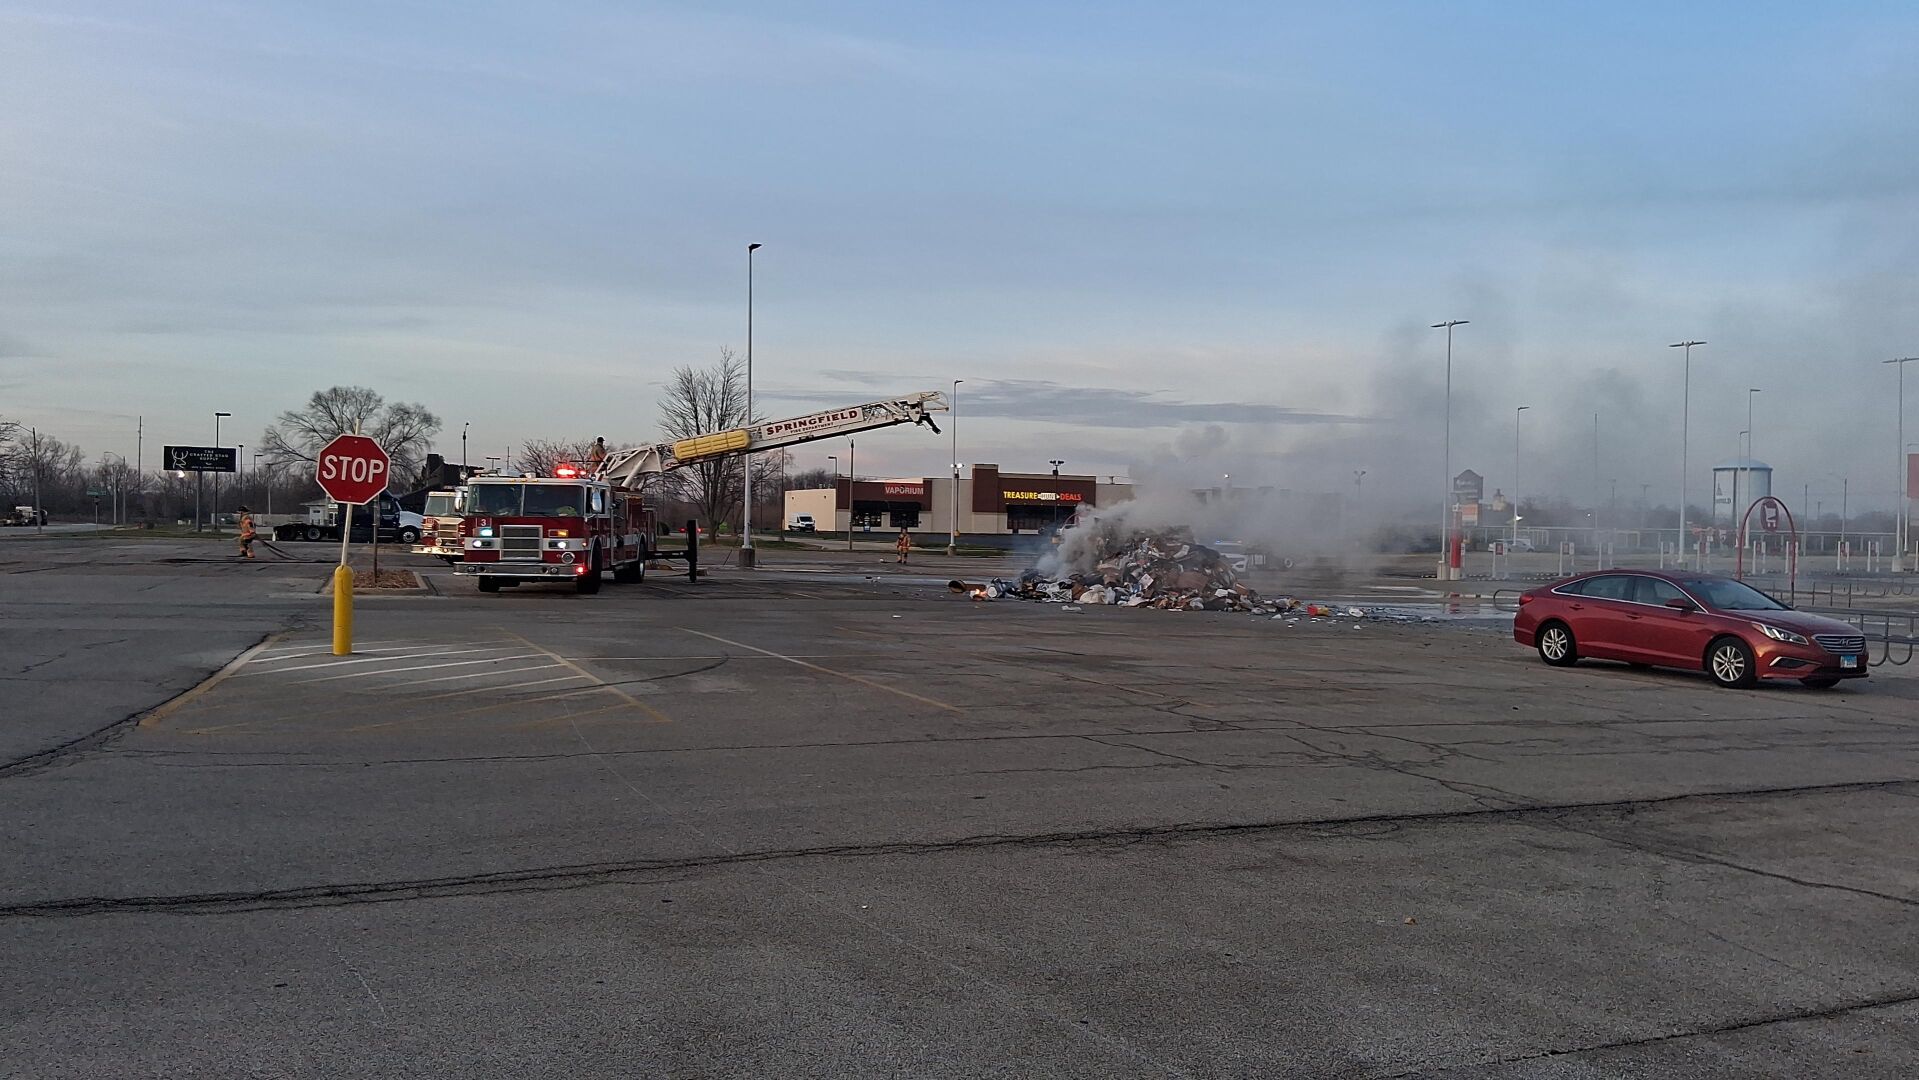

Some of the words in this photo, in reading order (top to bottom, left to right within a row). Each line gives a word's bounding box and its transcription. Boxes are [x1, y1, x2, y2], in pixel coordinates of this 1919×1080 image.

[766, 410, 858, 435] SPRINGFIELD
[322, 454, 385, 483] STOP
[885, 486, 924, 495] VAPORIUM
[1003, 491, 1038, 500] TREASURE
[1060, 493, 1082, 501] DEALS
